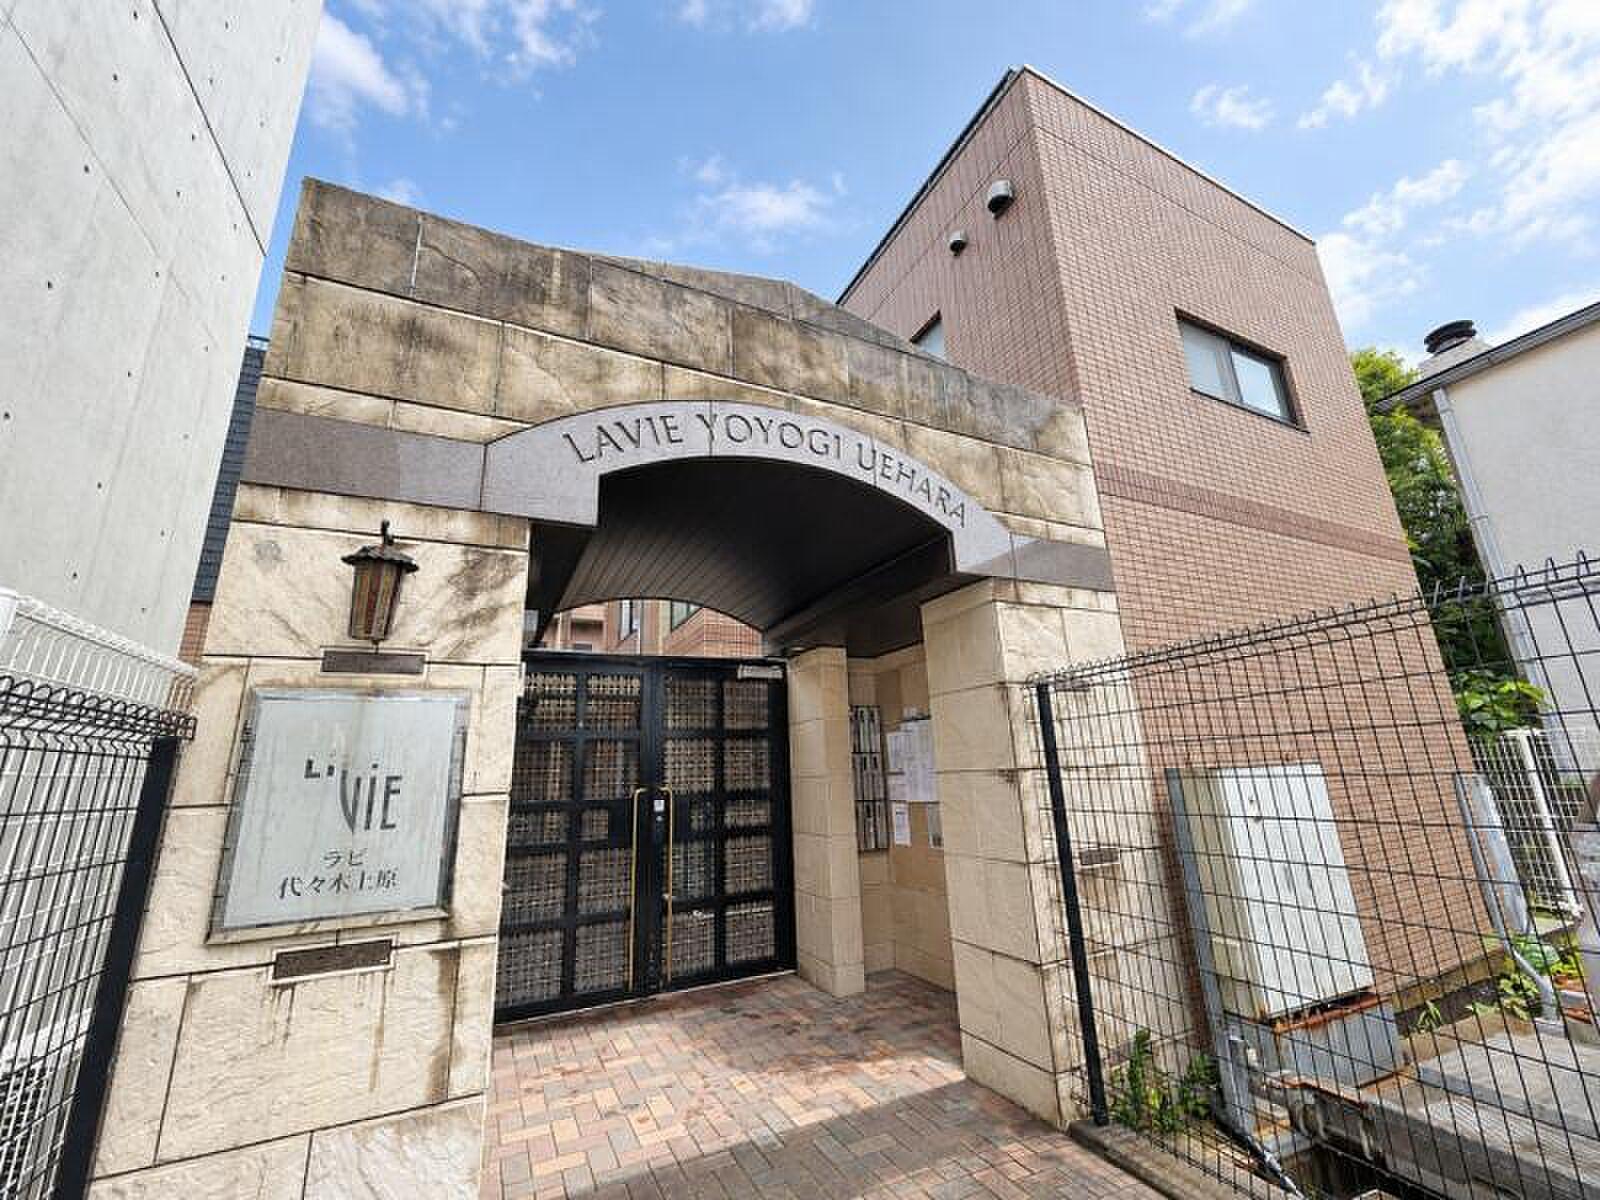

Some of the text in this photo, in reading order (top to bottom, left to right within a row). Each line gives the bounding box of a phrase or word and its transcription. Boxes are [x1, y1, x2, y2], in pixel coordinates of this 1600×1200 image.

[563, 412, 968, 529] LAVIE YOYOGI UEHARA
[279, 869, 399, 899] 代々木上原
